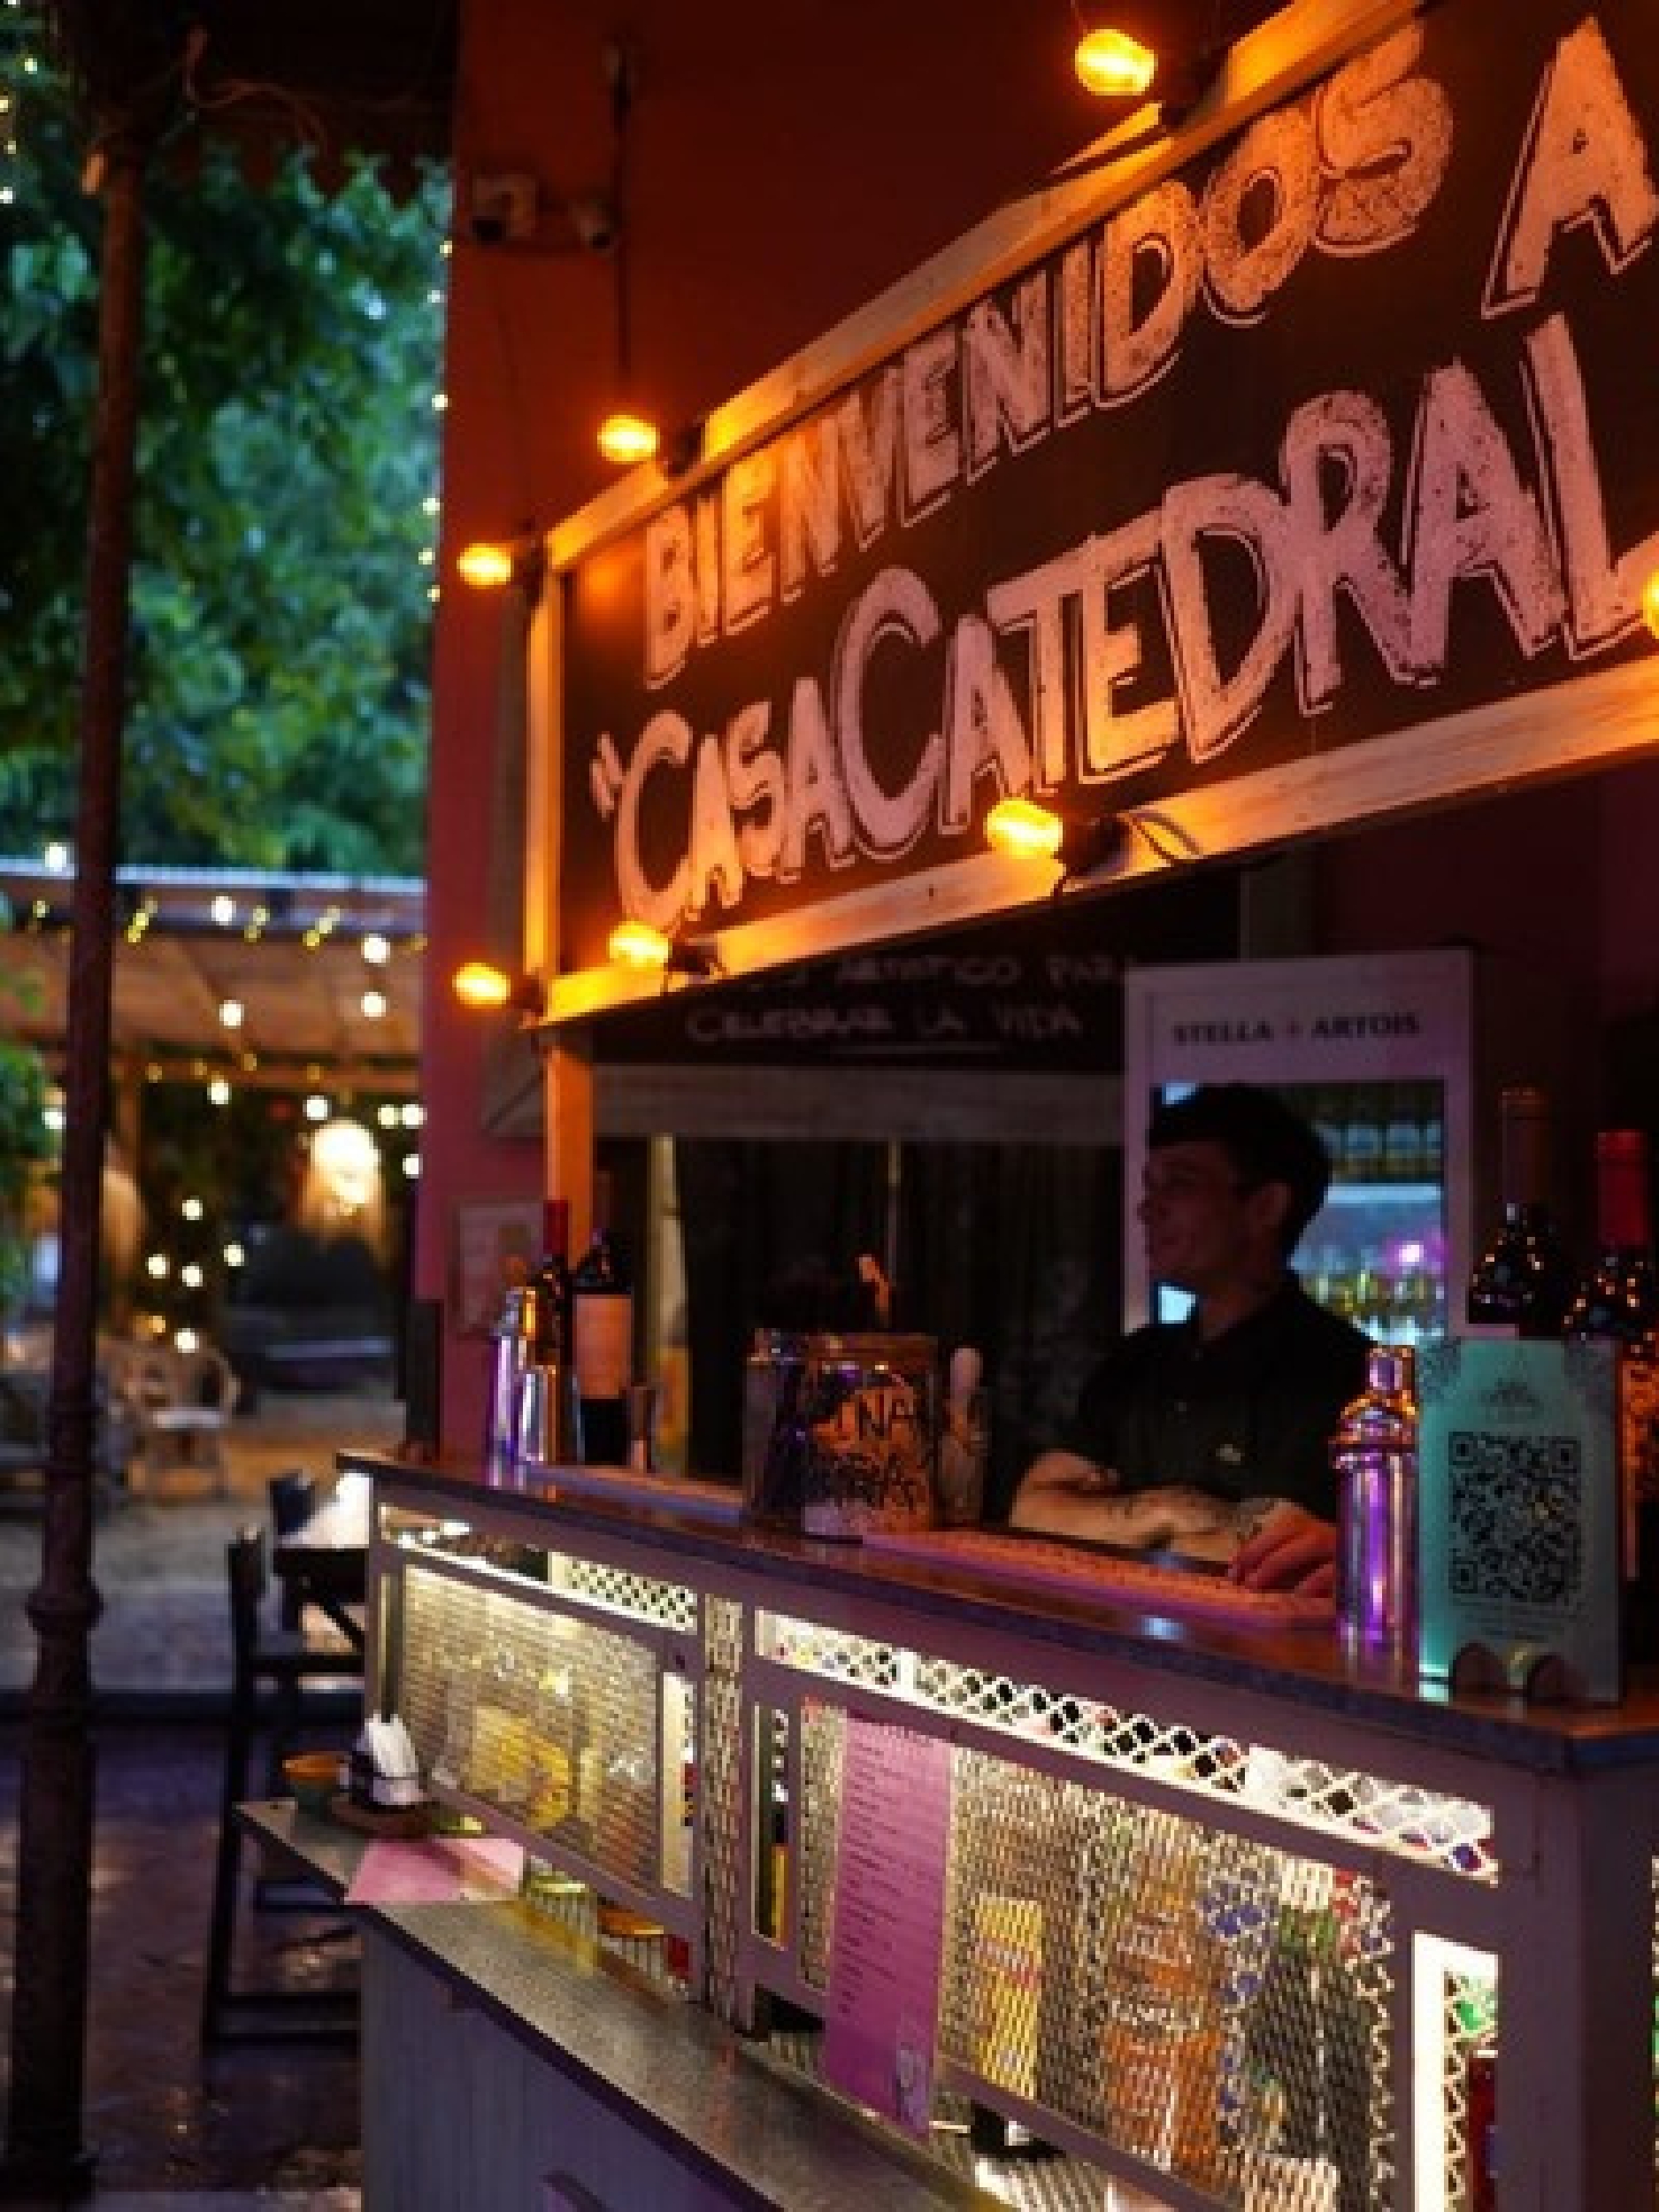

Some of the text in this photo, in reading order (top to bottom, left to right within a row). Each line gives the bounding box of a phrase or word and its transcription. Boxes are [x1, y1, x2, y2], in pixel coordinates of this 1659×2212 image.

[644, 16, 1659, 689] BIENVENIDOS A
[1045, 954, 1138, 987] PAR
[915, 1005, 968, 1036] LA
[992, 1002, 1084, 1037] VIDA
[1172, 1011, 1419, 1046] STELLA ARTOIS
